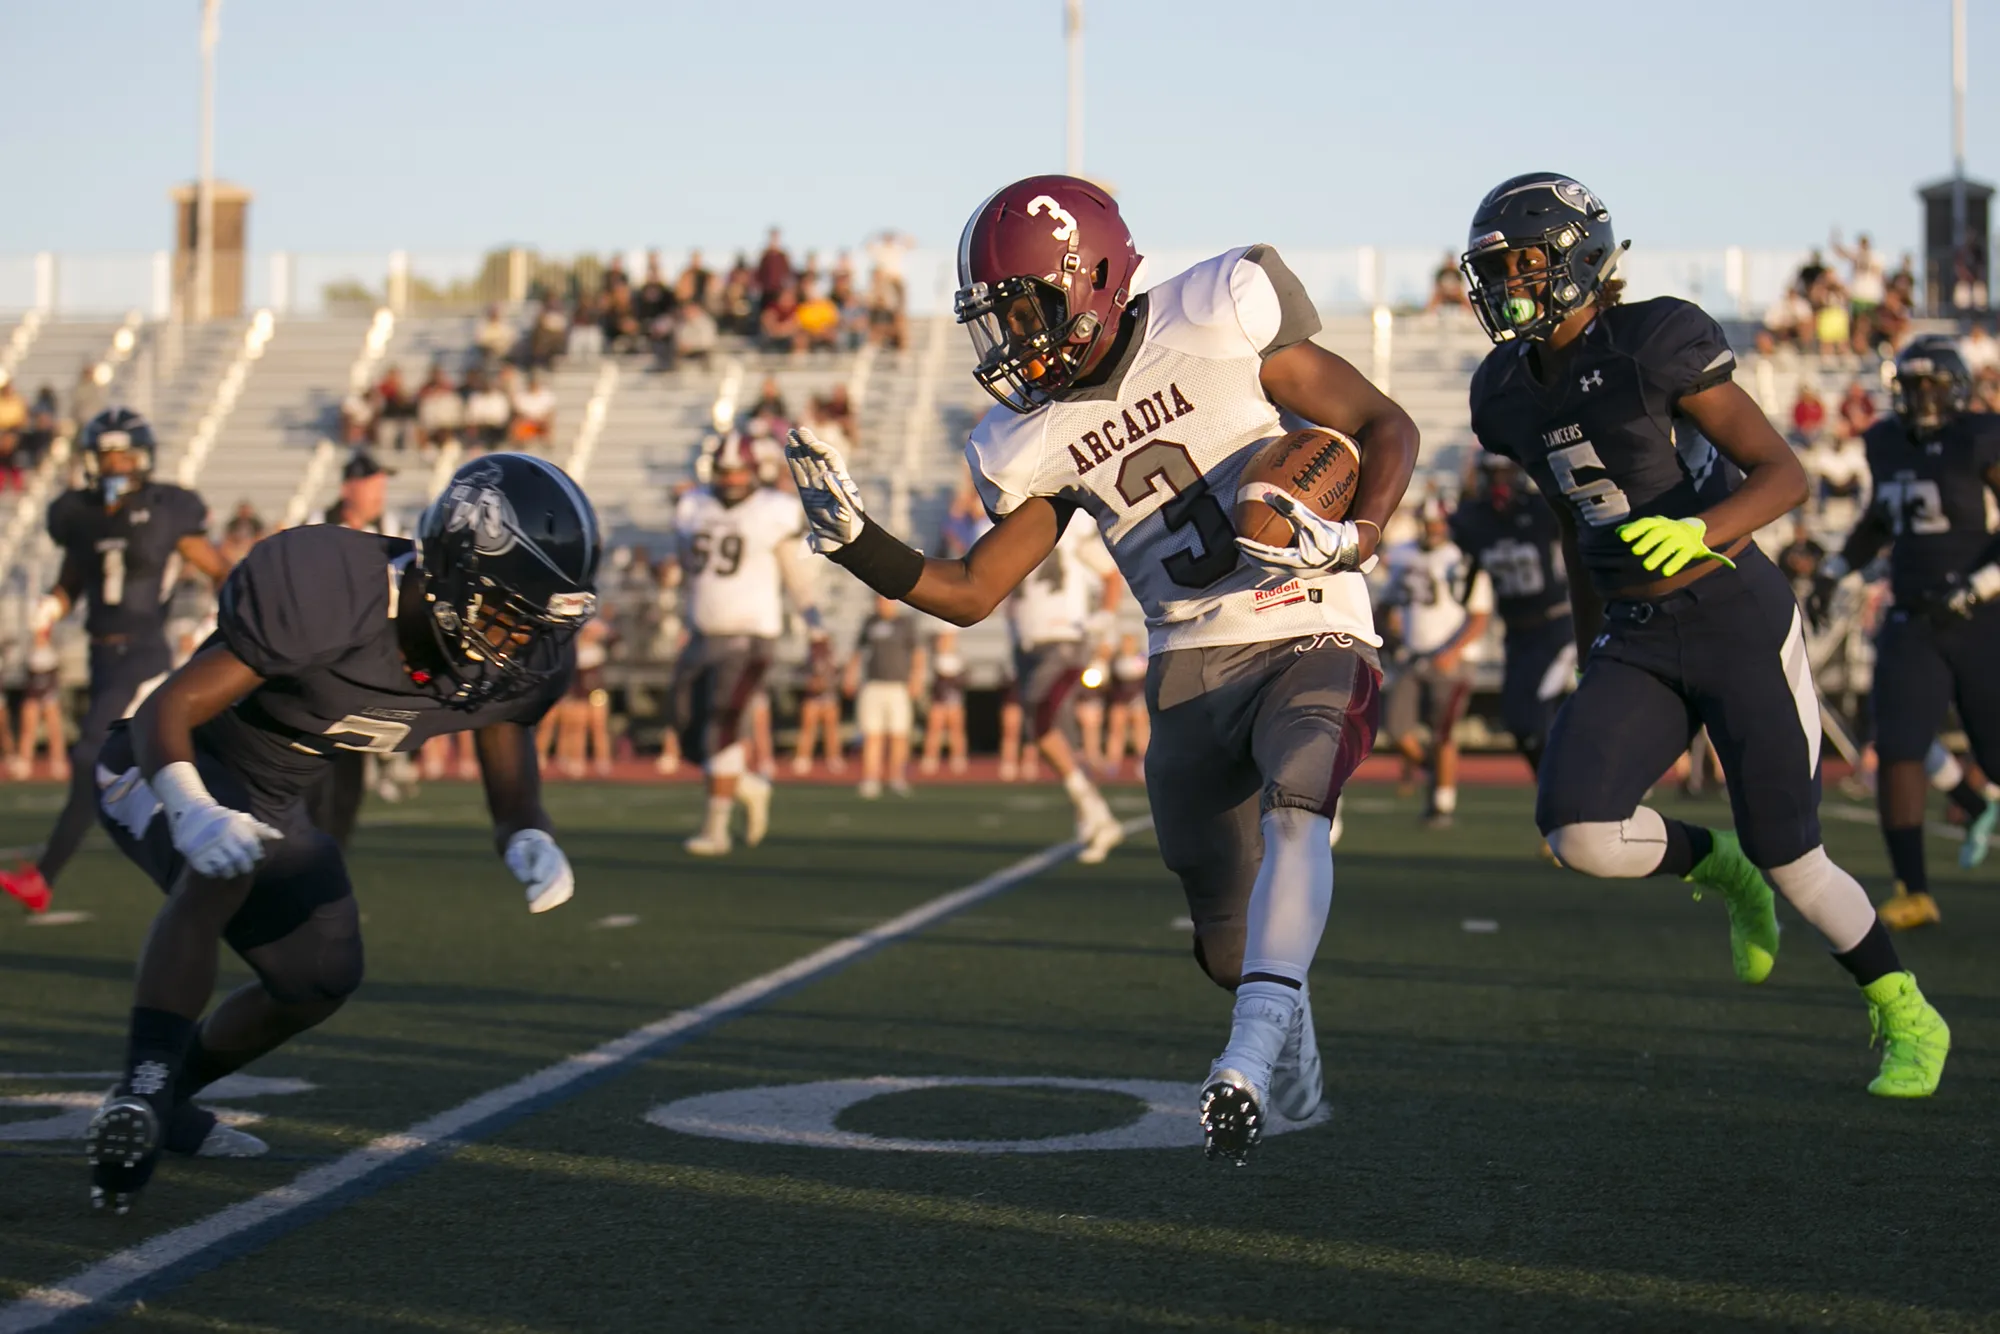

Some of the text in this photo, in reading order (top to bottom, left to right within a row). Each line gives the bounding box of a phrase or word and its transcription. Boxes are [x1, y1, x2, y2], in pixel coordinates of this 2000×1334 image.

[1027, 195, 1077, 240] 3
[1067, 382, 1195, 476] ARCADIA
[1542, 422, 1584, 448] LANCERS
[1317, 469, 1357, 510] Wilson
[1114, 438, 1240, 589] 3
[1254, 580, 1300, 602] Riddell
